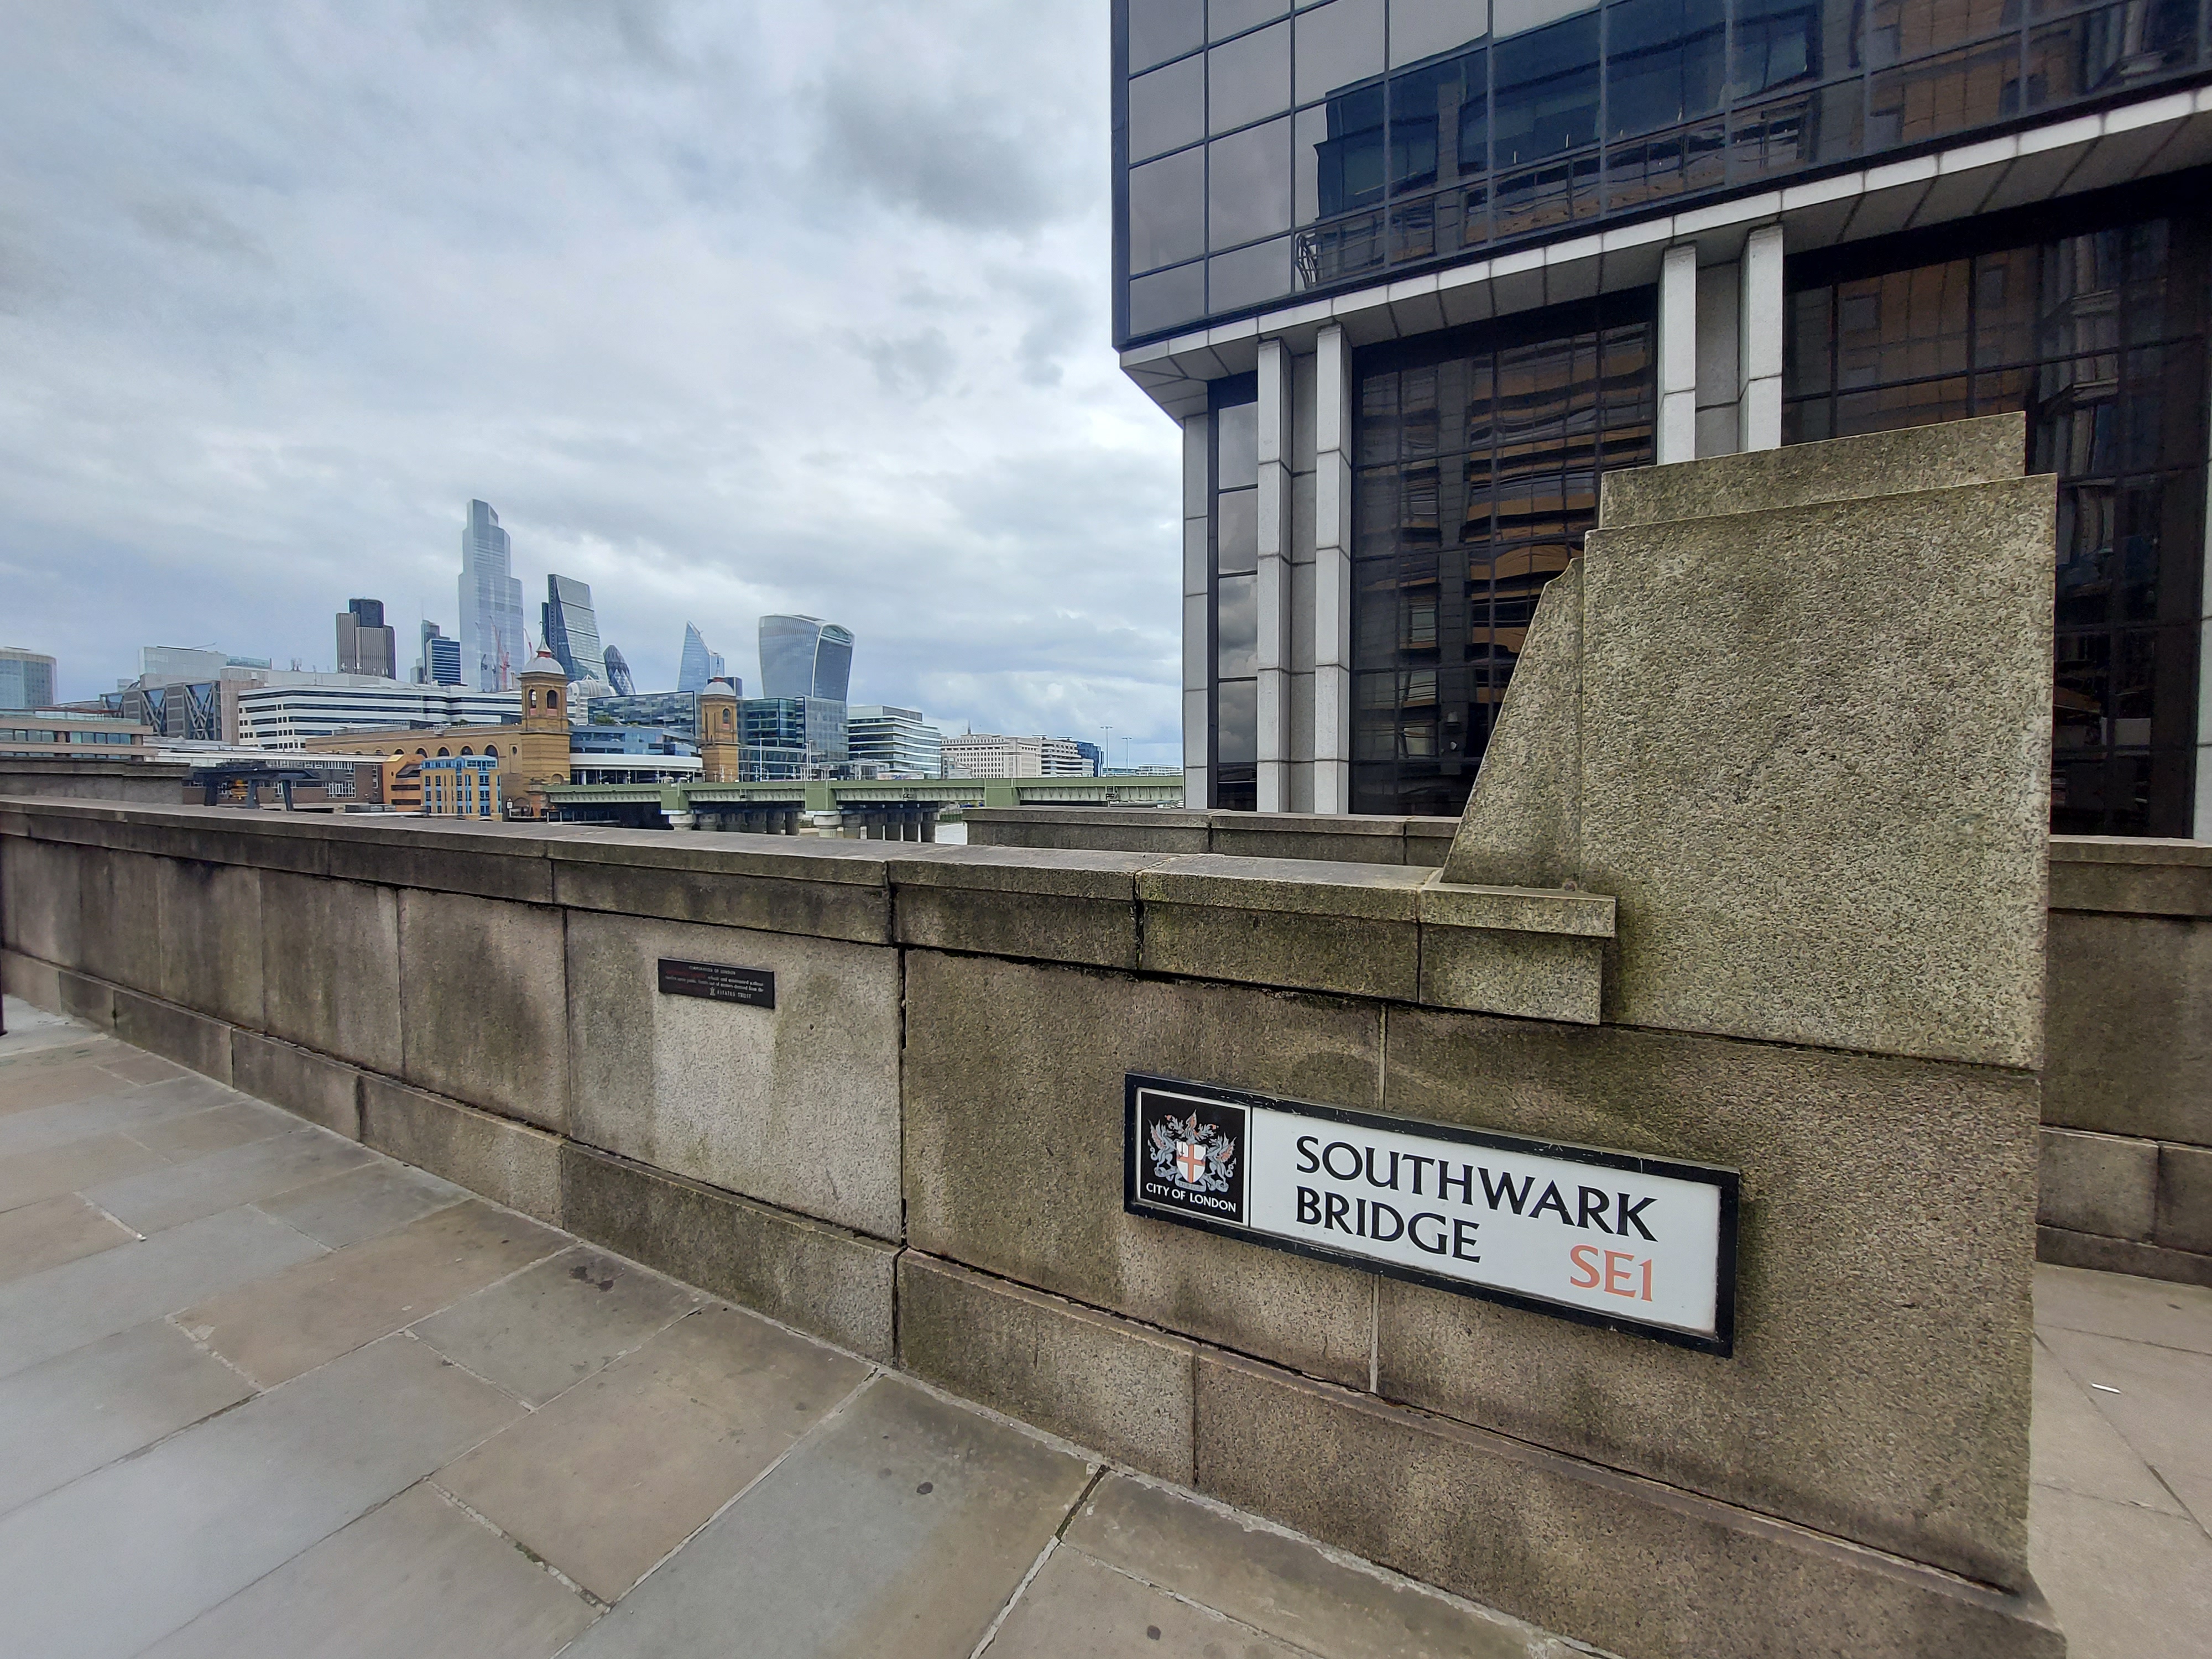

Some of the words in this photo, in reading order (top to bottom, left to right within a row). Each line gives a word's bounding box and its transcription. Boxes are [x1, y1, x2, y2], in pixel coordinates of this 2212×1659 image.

[1146, 1182, 1170, 1196] CITY
[1171, 1188, 1186, 1201] OF
[1190, 1192, 1237, 1213] LONDON
[1296, 1135, 1658, 1243] SOUTHWARK
[1296, 1185, 1481, 1263] BRIDGE
[1569, 1244, 1653, 1302] SE1
